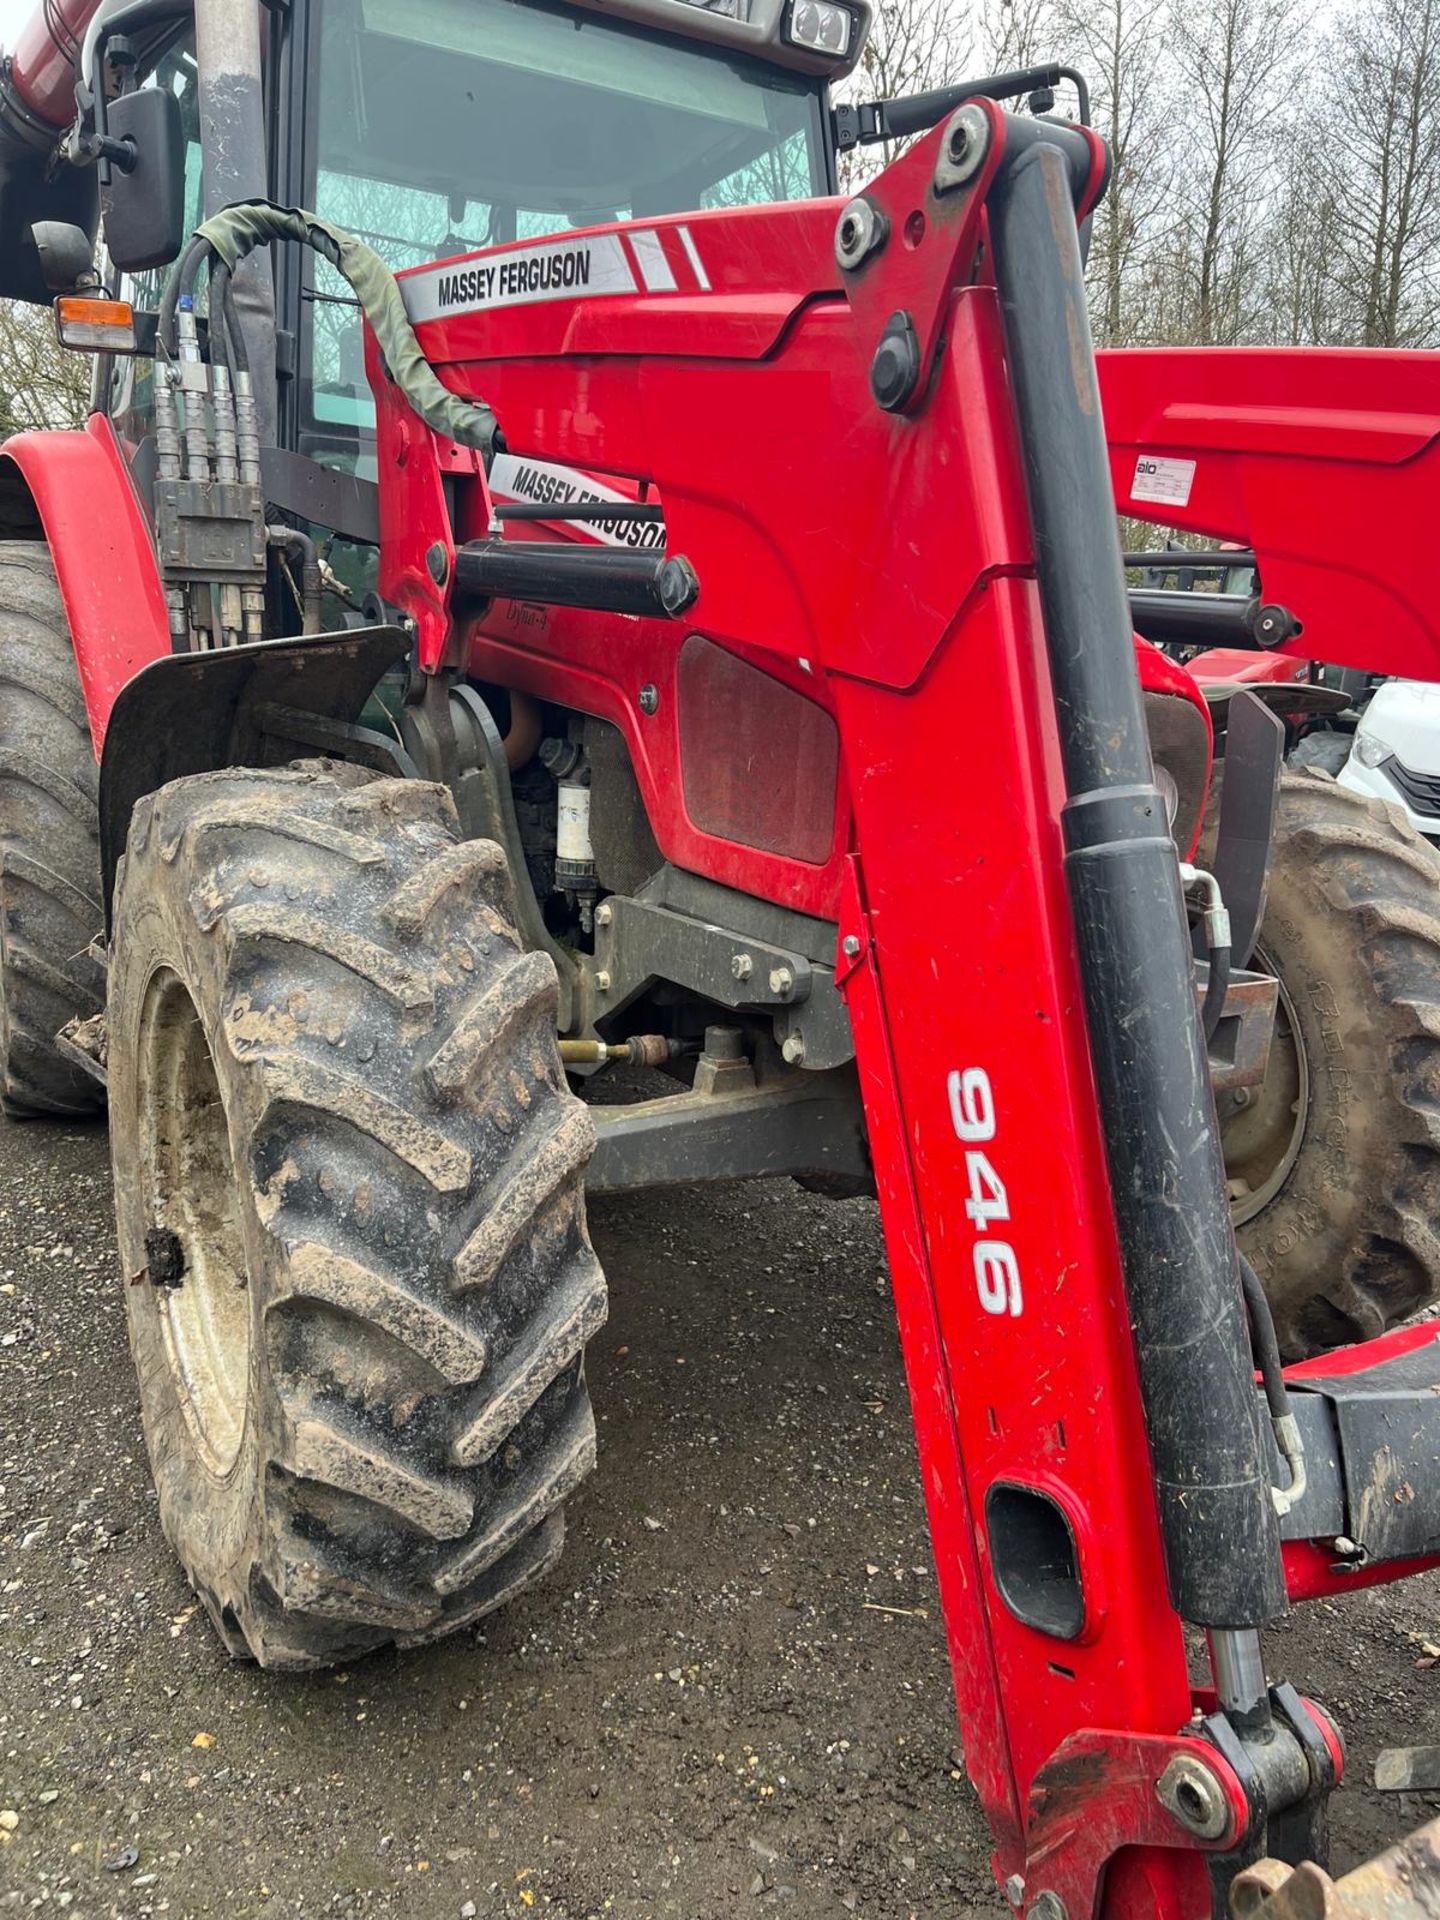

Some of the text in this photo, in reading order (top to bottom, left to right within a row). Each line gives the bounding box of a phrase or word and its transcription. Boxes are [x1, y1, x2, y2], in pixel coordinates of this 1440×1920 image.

[438, 250, 591, 307] MASSEY FERGUSON
[1137, 461, 1157, 475] alo
[512, 466, 667, 548] MASSEY GUSON
[947, 1067, 1023, 1317] 946
